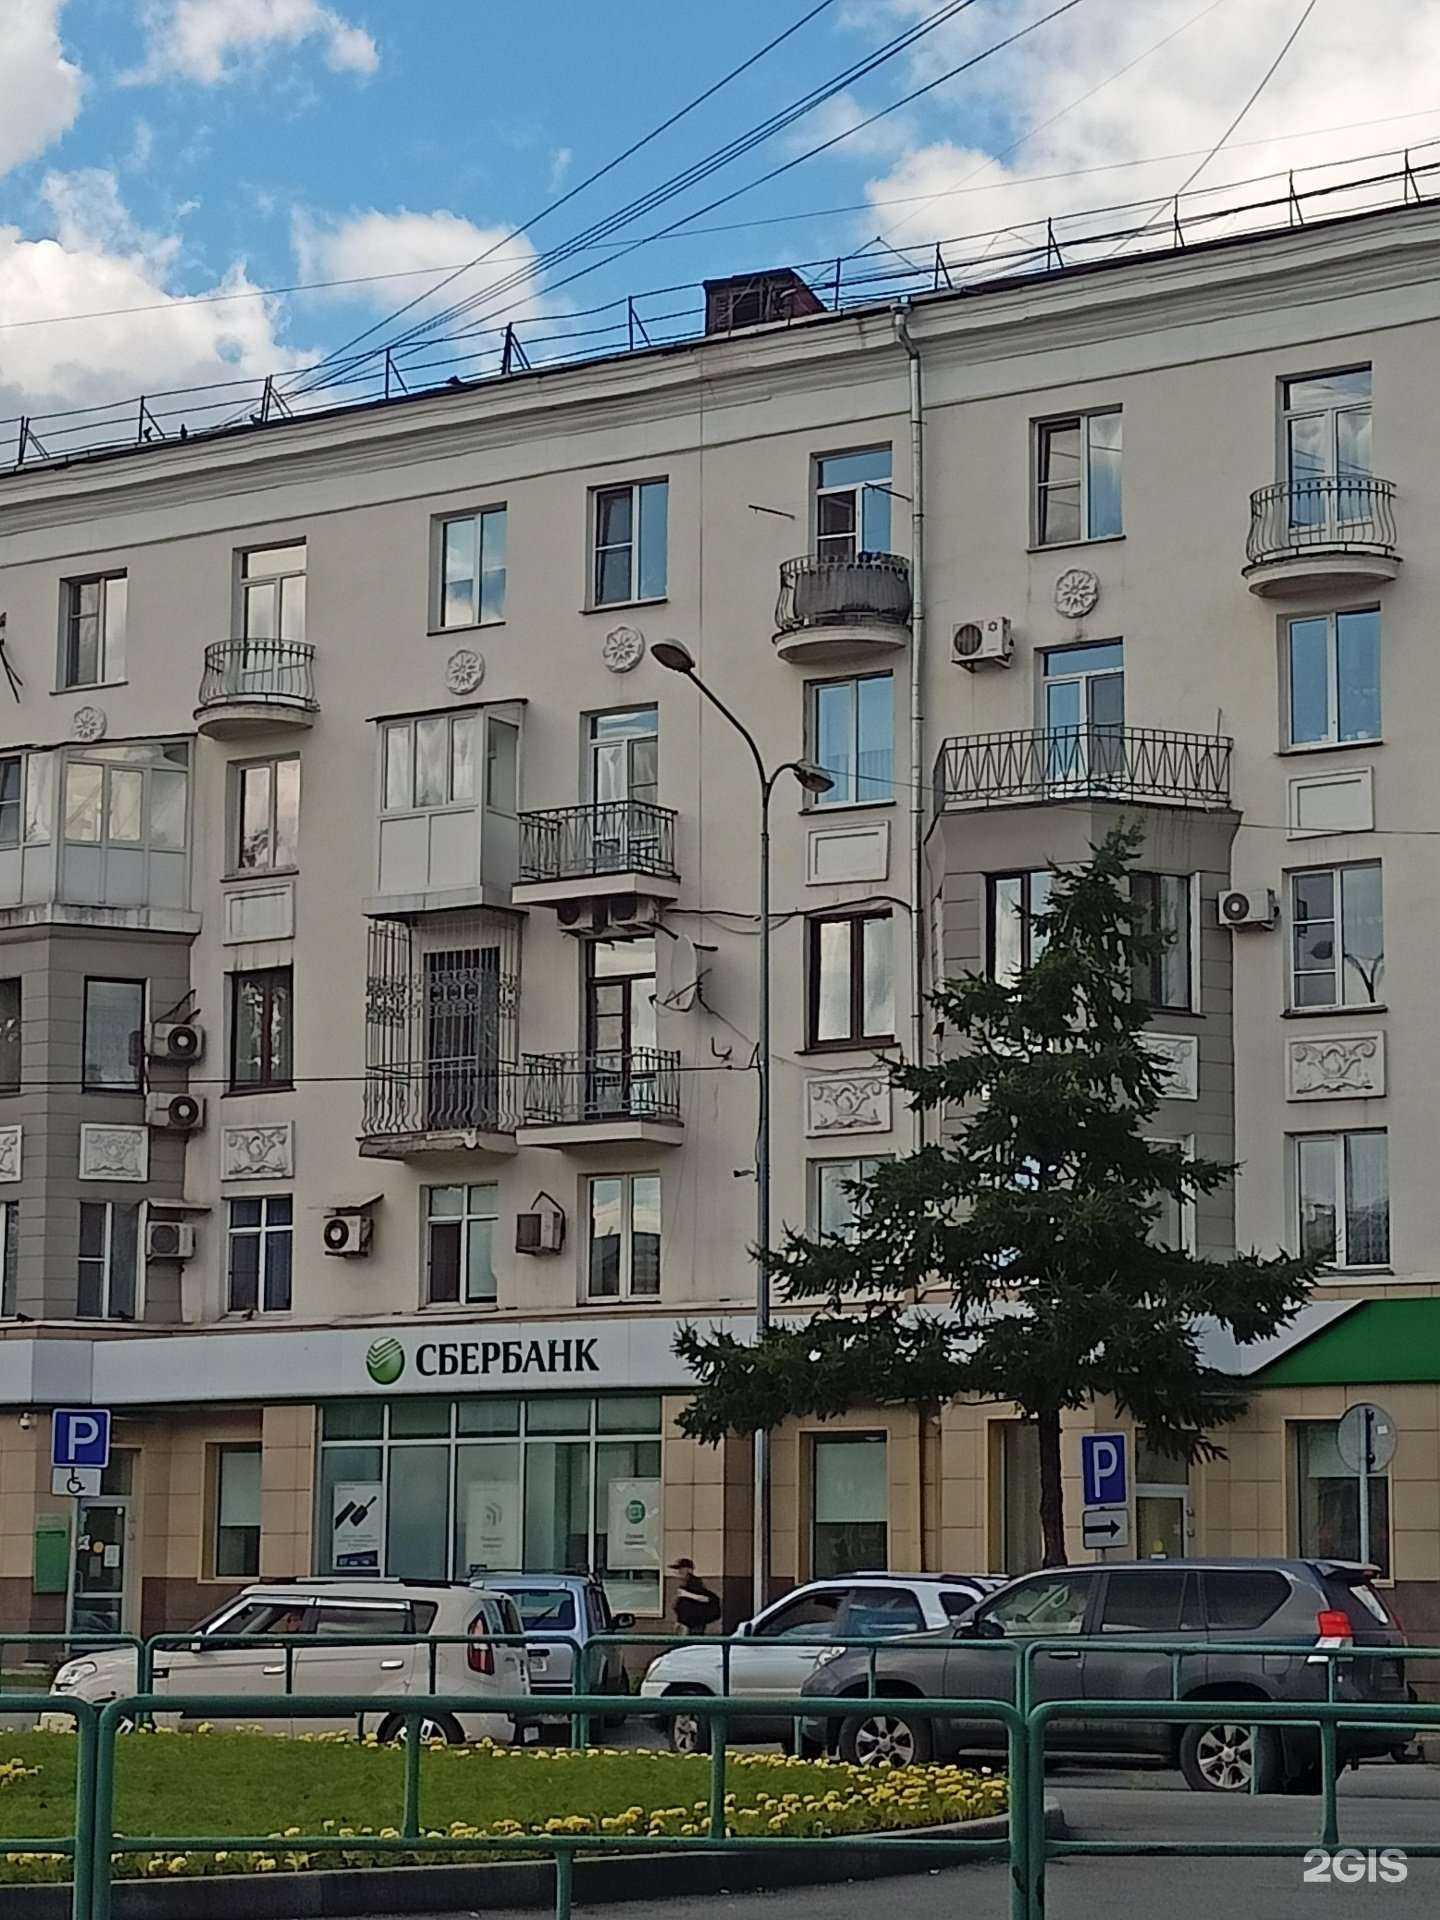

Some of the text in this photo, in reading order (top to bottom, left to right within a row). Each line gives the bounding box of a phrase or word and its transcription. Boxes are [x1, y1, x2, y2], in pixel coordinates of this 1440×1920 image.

[415, 1338, 600, 1376] СБЕРБАНК
[67, 1416, 99, 1460] P
[1093, 1441, 1118, 1498] P
